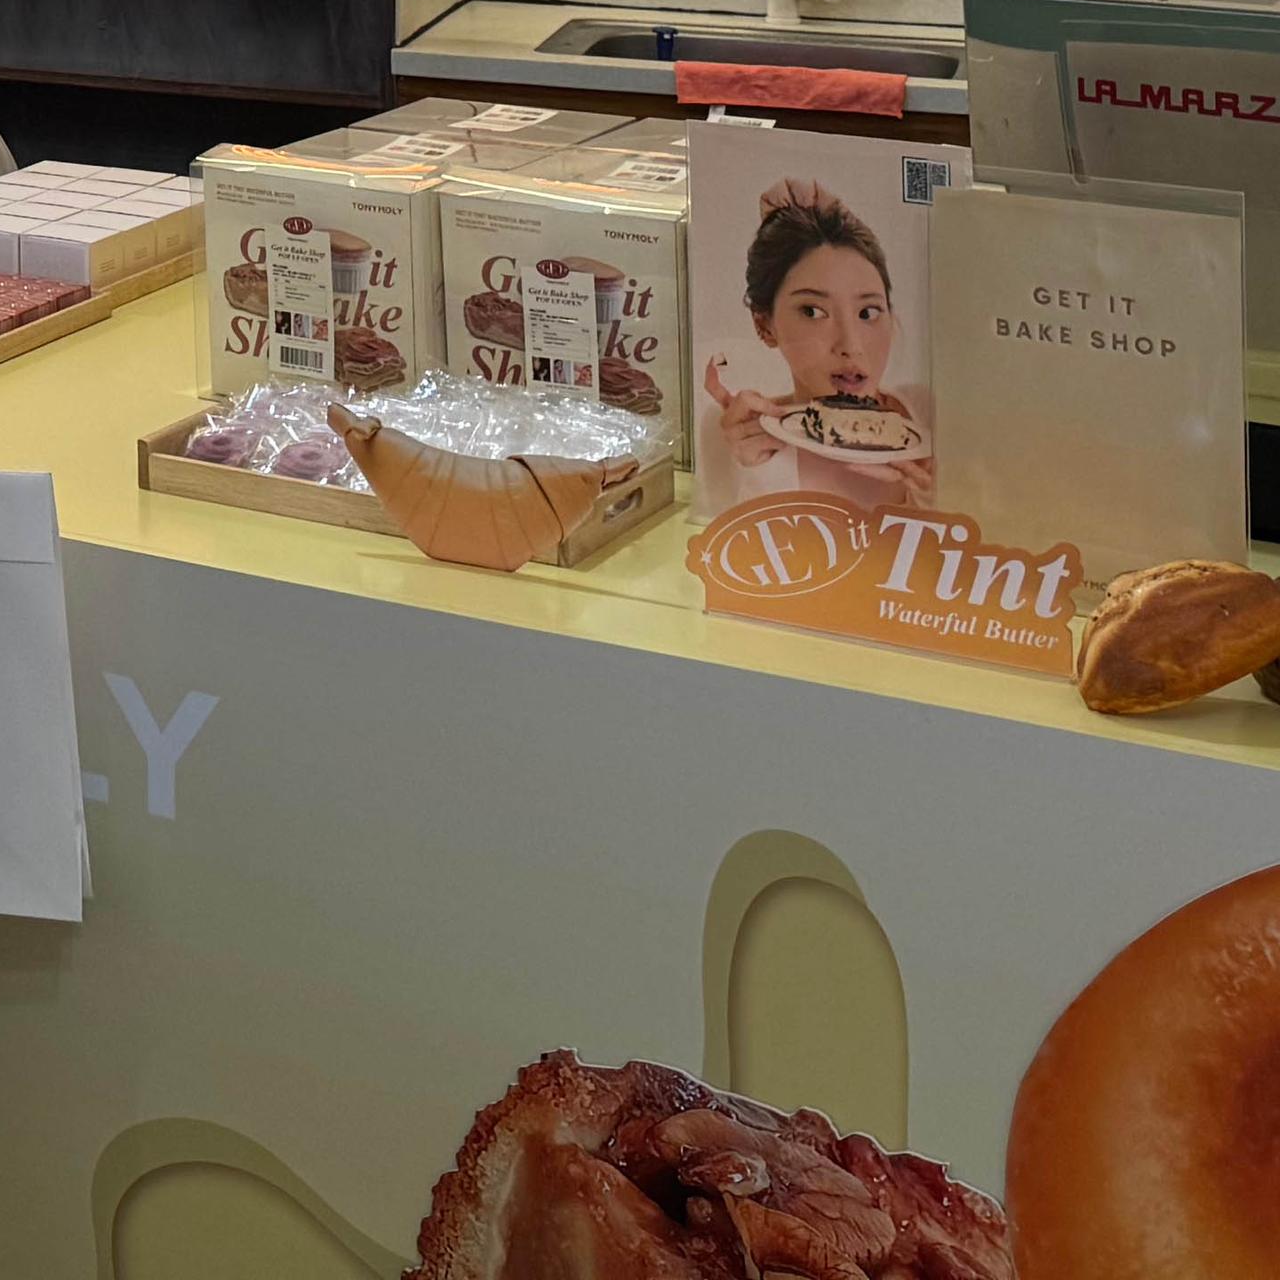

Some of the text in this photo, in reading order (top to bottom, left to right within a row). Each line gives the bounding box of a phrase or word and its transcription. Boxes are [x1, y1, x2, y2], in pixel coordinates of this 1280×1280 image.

[1077, 77, 1280, 123] LA MARZ
[351, 201, 403, 216] TONYMOLY
[603, 229, 659, 244] TONYMOLY
[368, 250, 397, 288] it
[332, 290, 403, 333] ake
[621, 278, 653, 319] it
[1033, 286, 1136, 315] GET IT
[225, 315, 270, 358] Sh
[598, 320, 659, 363] ke
[996, 318, 1176, 357] BAKE SHOP
[467, 345, 528, 388] Sh
[719, 513, 1072, 619] GET it Tint
[878, 600, 1059, 650] Waterful Butter
